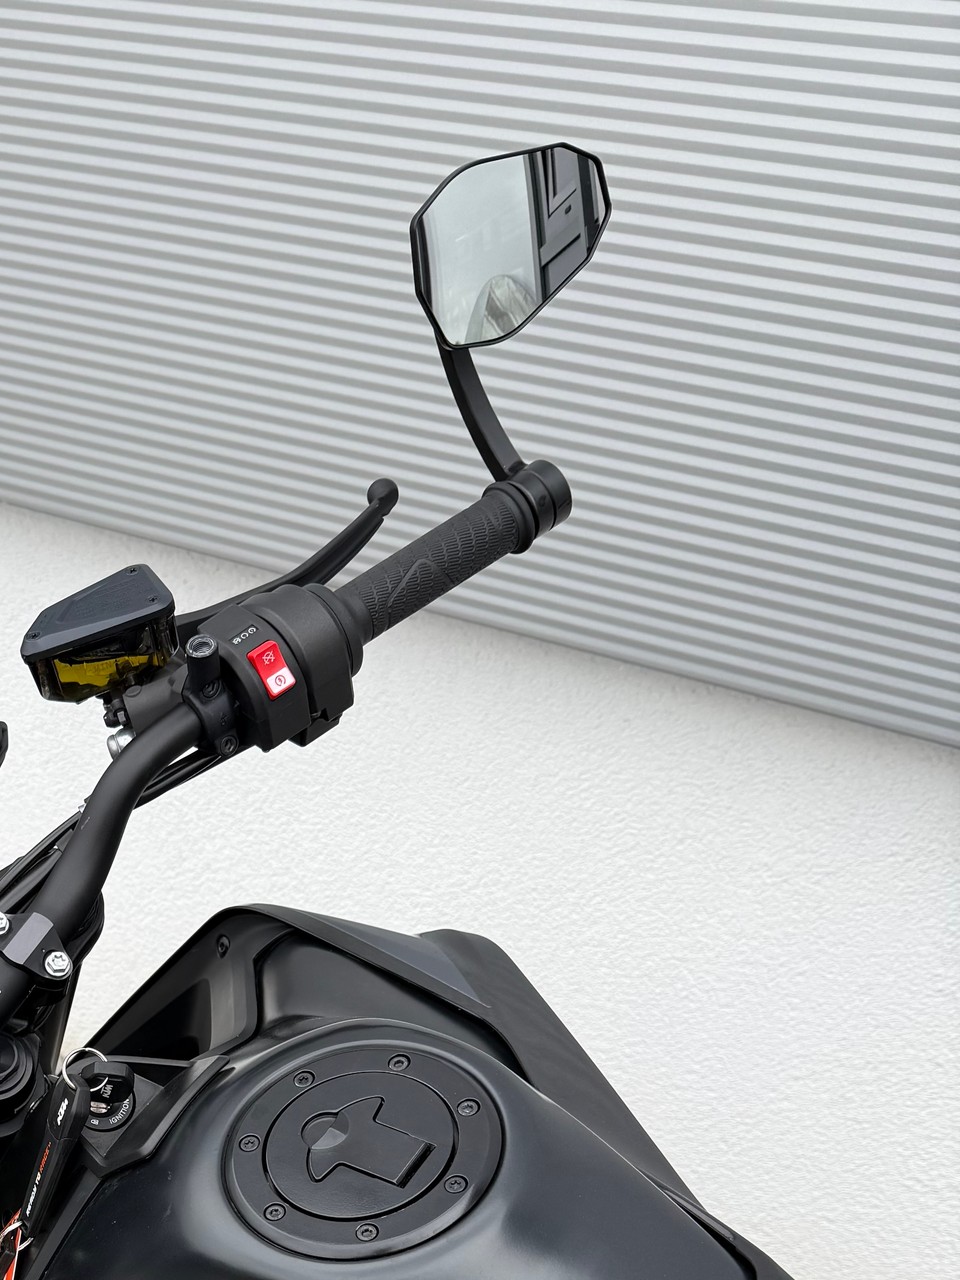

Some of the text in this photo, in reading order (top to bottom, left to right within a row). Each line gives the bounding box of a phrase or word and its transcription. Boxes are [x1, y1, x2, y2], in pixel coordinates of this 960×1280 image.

[100, 1084, 114, 1098] KTM
[57, 1098, 69, 1126] KTM
[109, 1098, 130, 1124] IGNITION
[26, 1184, 37, 1217] READY
[35, 1171, 42, 1185] TO
